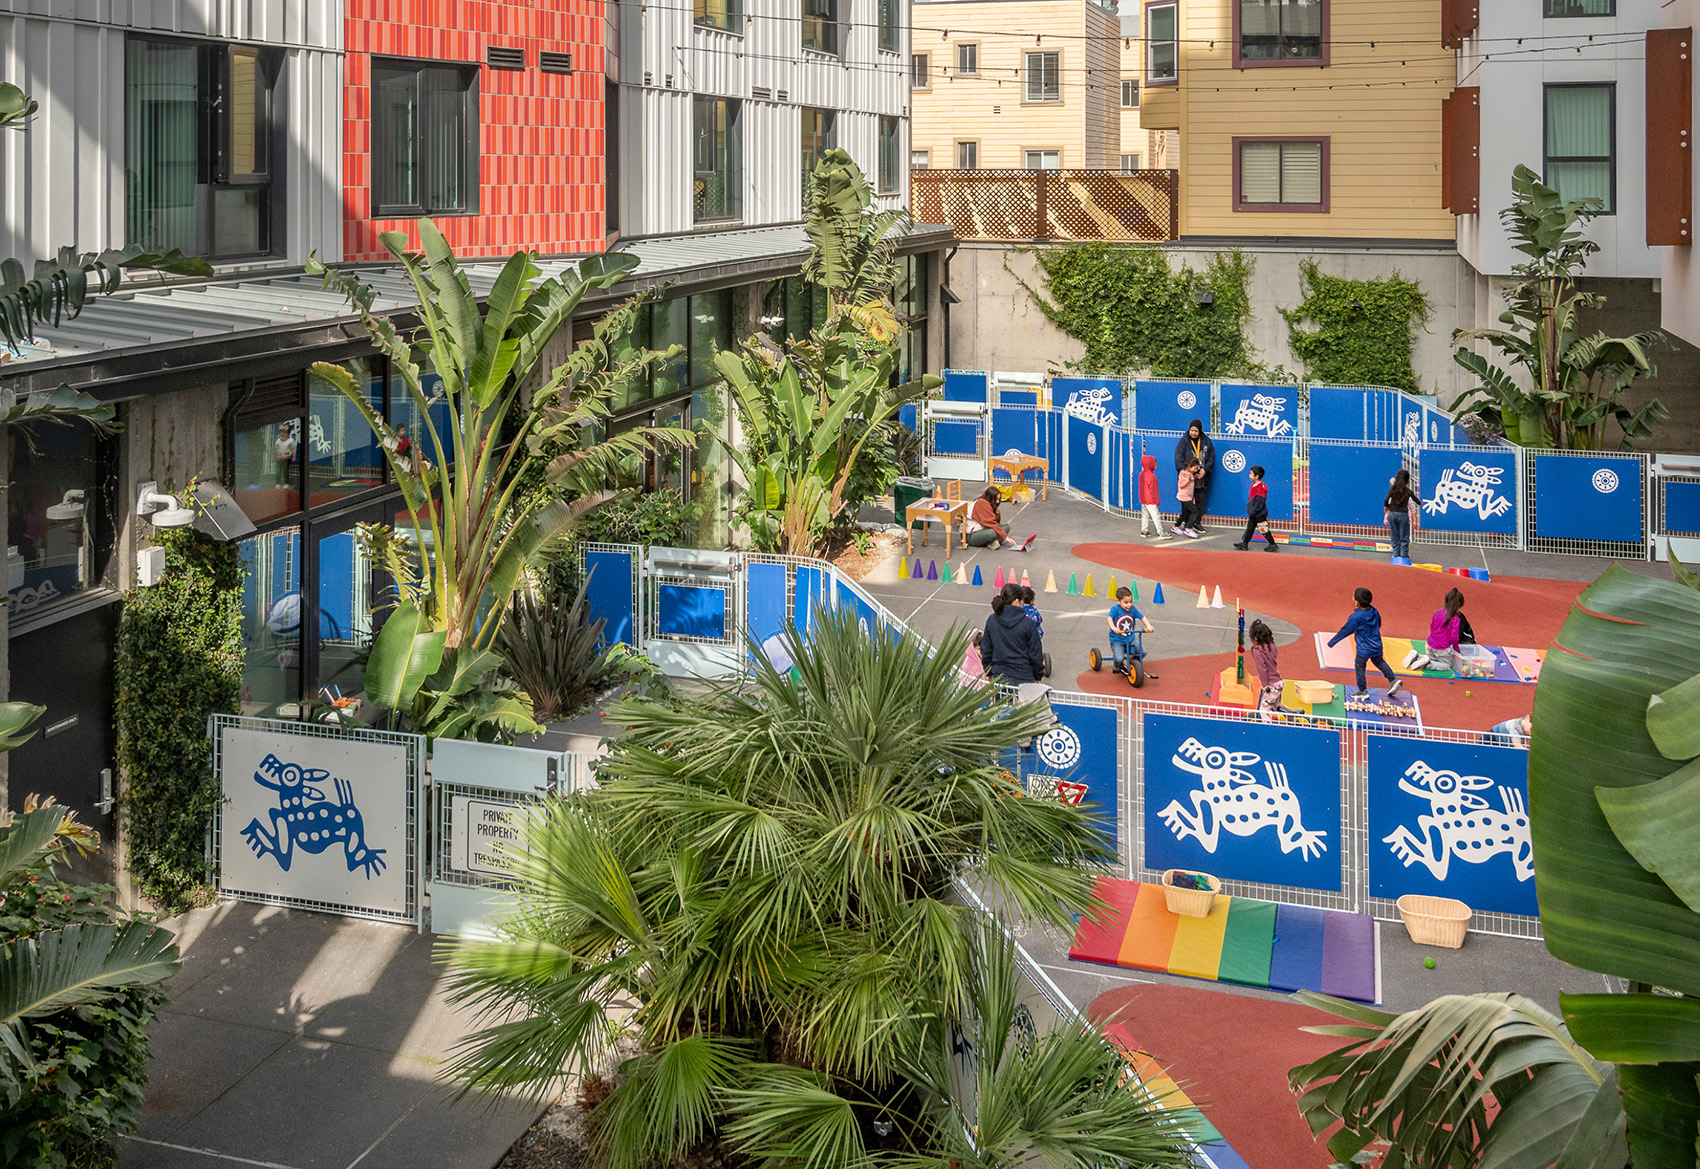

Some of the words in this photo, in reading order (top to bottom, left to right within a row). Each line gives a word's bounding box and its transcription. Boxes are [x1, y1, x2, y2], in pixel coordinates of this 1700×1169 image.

[483, 809, 513, 825] PRIVATE
[477, 823, 519, 840] PROPERTY
[492, 841, 504, 854] NO
